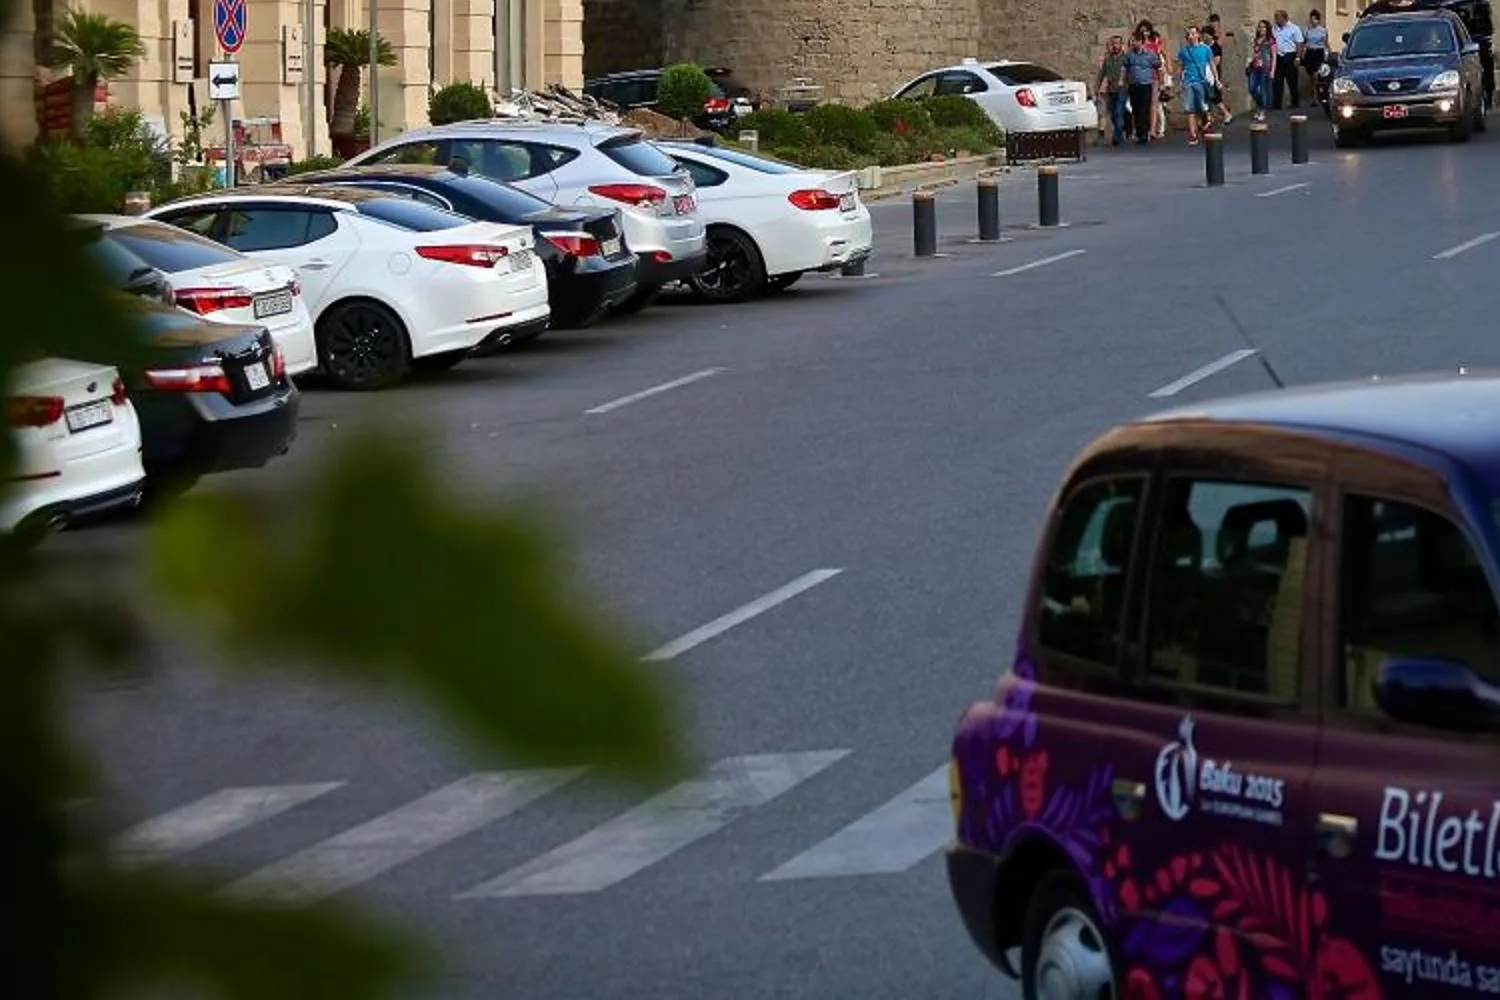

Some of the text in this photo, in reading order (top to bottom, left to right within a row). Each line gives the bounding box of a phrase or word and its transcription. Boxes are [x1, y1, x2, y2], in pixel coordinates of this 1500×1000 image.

[1200, 759, 1284, 808] Baku 2015
[1380, 945, 1473, 985] saytında
